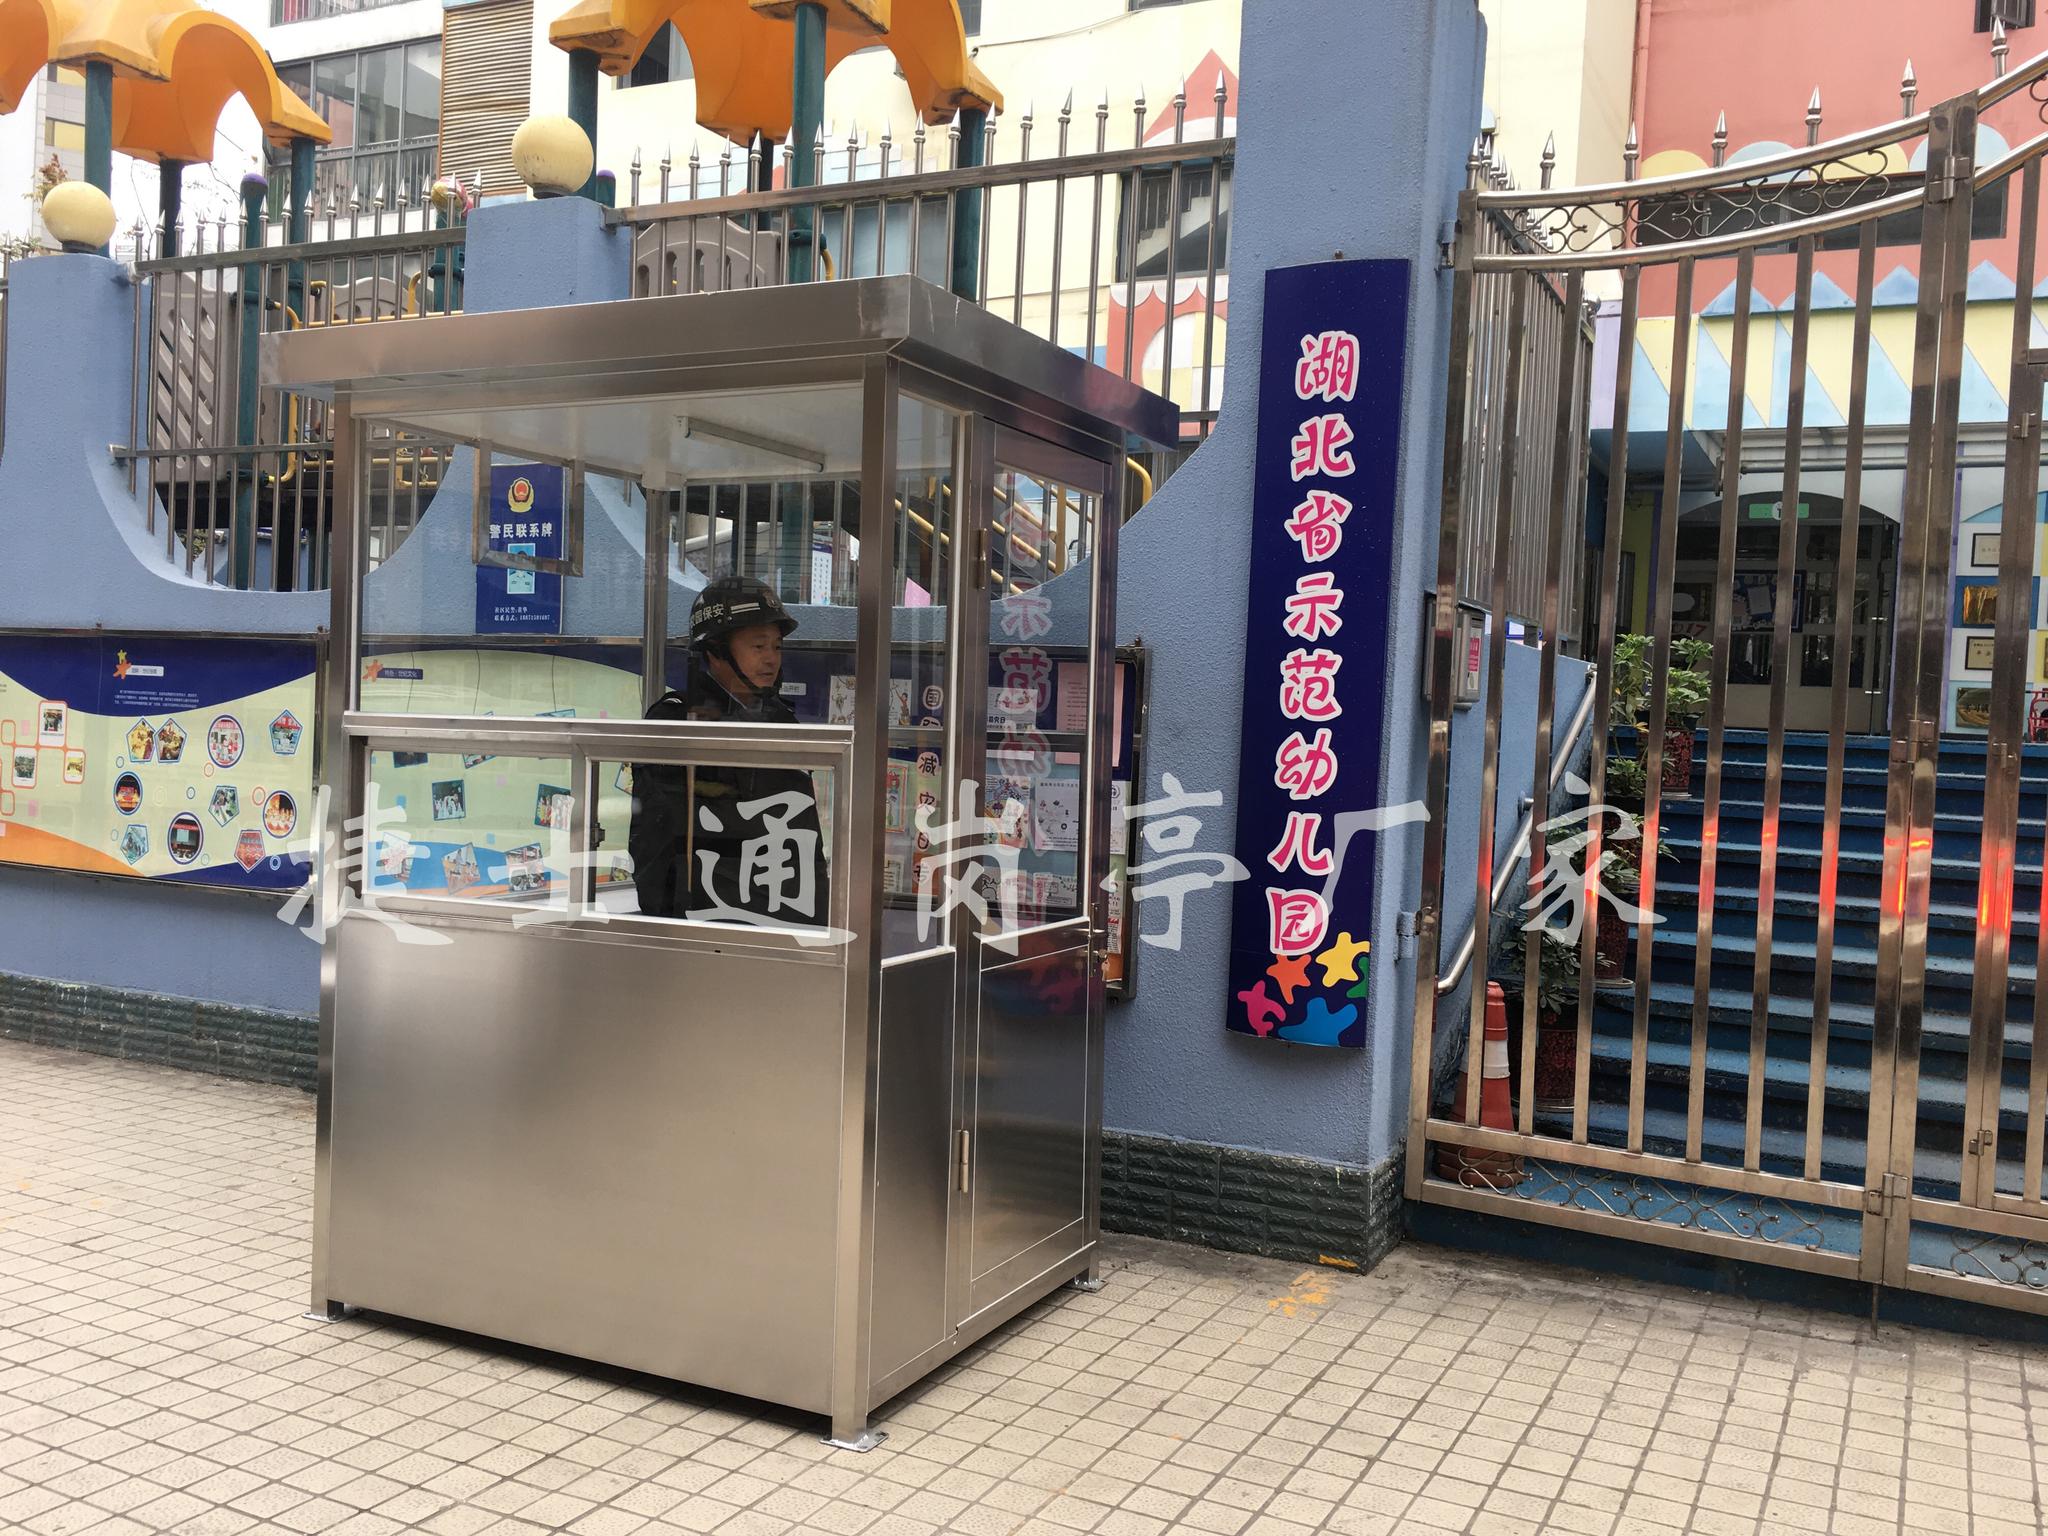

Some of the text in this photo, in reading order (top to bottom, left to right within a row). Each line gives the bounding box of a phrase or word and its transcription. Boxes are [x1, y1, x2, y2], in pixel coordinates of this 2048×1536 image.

[489, 522, 552, 539] 警民联系牌
[1265, 331, 1359, 955] 湖北省示范幼儿园
